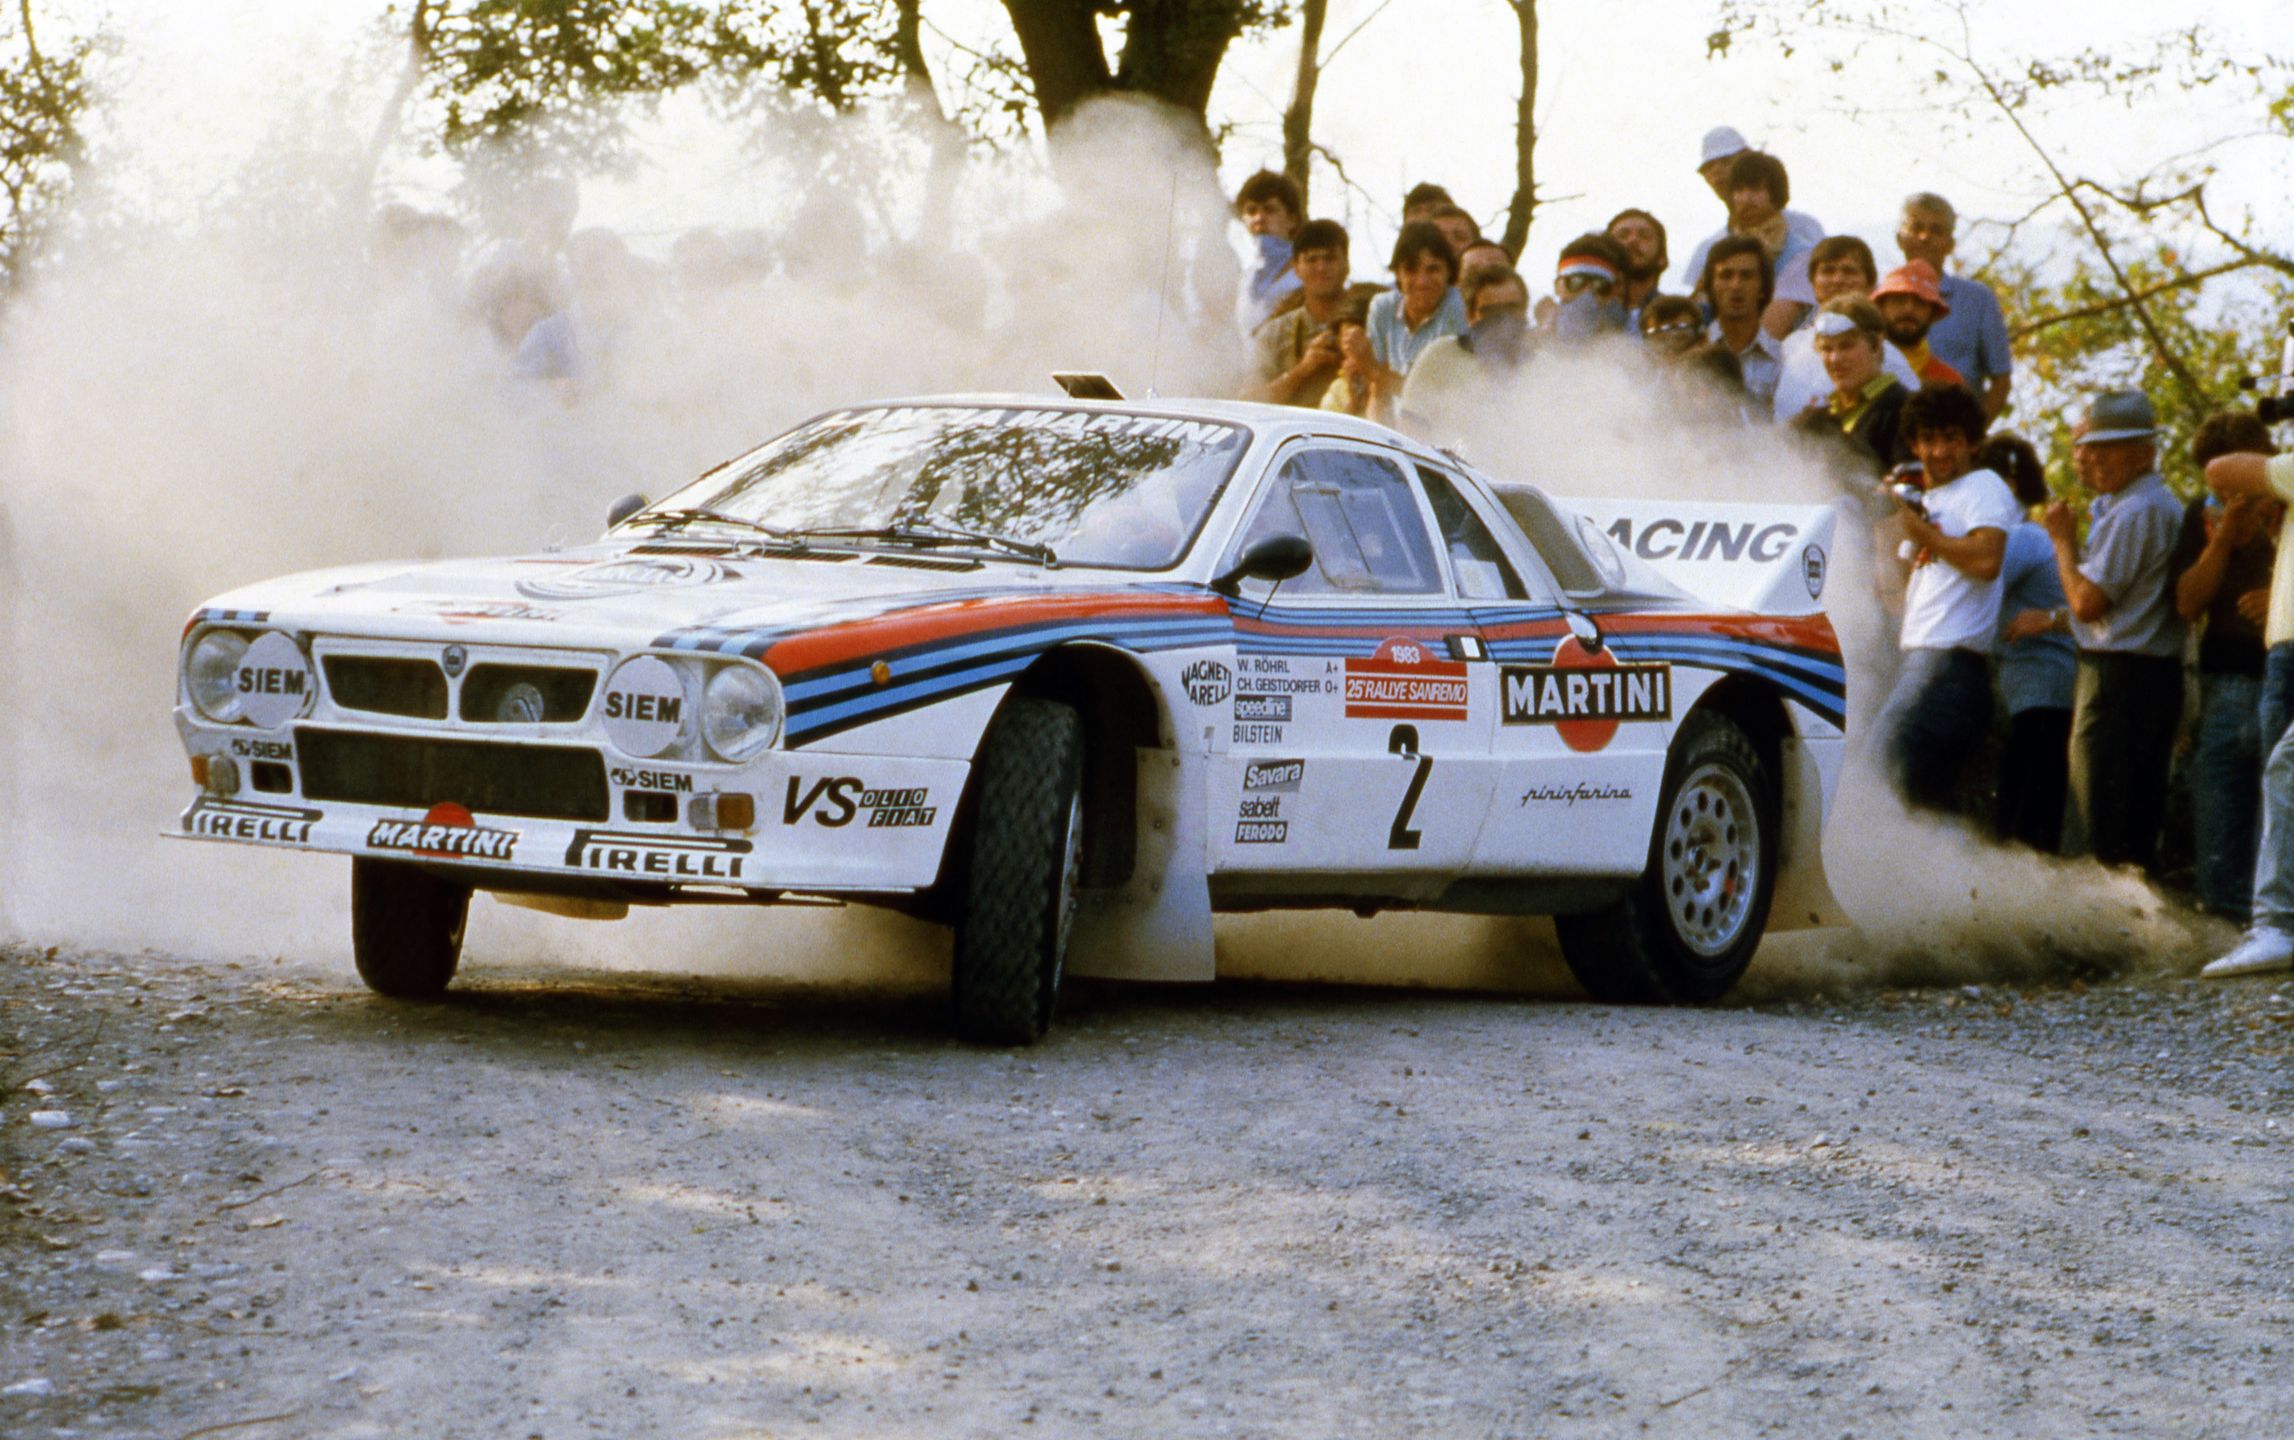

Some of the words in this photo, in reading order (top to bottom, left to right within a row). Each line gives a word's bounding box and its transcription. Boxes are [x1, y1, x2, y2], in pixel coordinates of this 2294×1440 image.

[1607, 517, 1798, 563] ACING
[1237, 658, 1251, 673] W.
[1255, 656, 1290, 673] RÖHRL
[1391, 646, 1420, 664] 1983
[238, 667, 305, 695] SIEM
[1255, 678, 1320, 694] GEISTDORFER
[1365, 680, 1406, 700] RALLYE
[1409, 682, 1466, 703] SANREMO
[605, 691, 682, 723] SIEM
[1507, 673, 1665, 716] MARTINI
[1233, 724, 1283, 743] BILSTEIN
[251, 740, 293, 759] SIEM
[638, 770, 693, 792] SIEM
[1246, 763, 1301, 788] Savara
[1388, 724, 1434, 850] 2
[783, 775, 864, 828] VS
[863, 789, 925, 806] OLIO
[1239, 796, 1280, 817] sabelt
[1522, 782, 1632, 807] pininfarina
[182, 796, 324, 843] PIRELLI
[873, 810, 933, 825] FIAT
[372, 821, 513, 857] MARTINI
[1237, 824, 1285, 841] FERODO
[565, 829, 754, 878] PIRELLI
